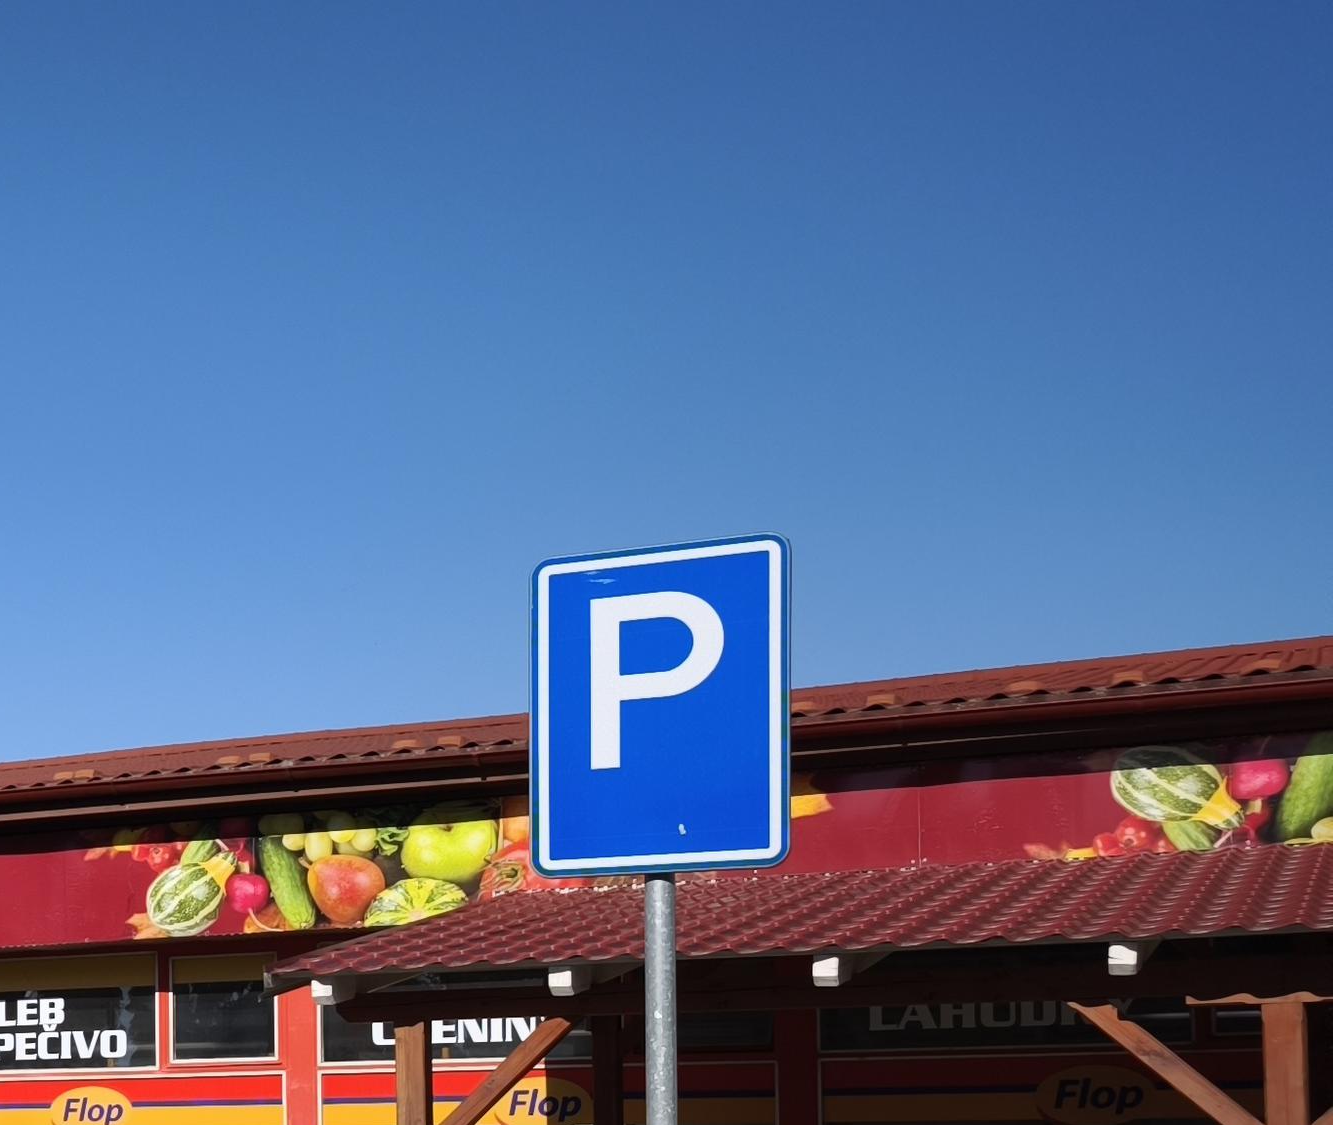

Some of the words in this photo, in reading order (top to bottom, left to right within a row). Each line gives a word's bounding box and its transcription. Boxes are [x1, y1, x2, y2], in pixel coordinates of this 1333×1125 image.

[589, 590, 725, 771] P
[509, 1088, 582, 1121] Flop
[1054, 1078, 1144, 1113] Flop
